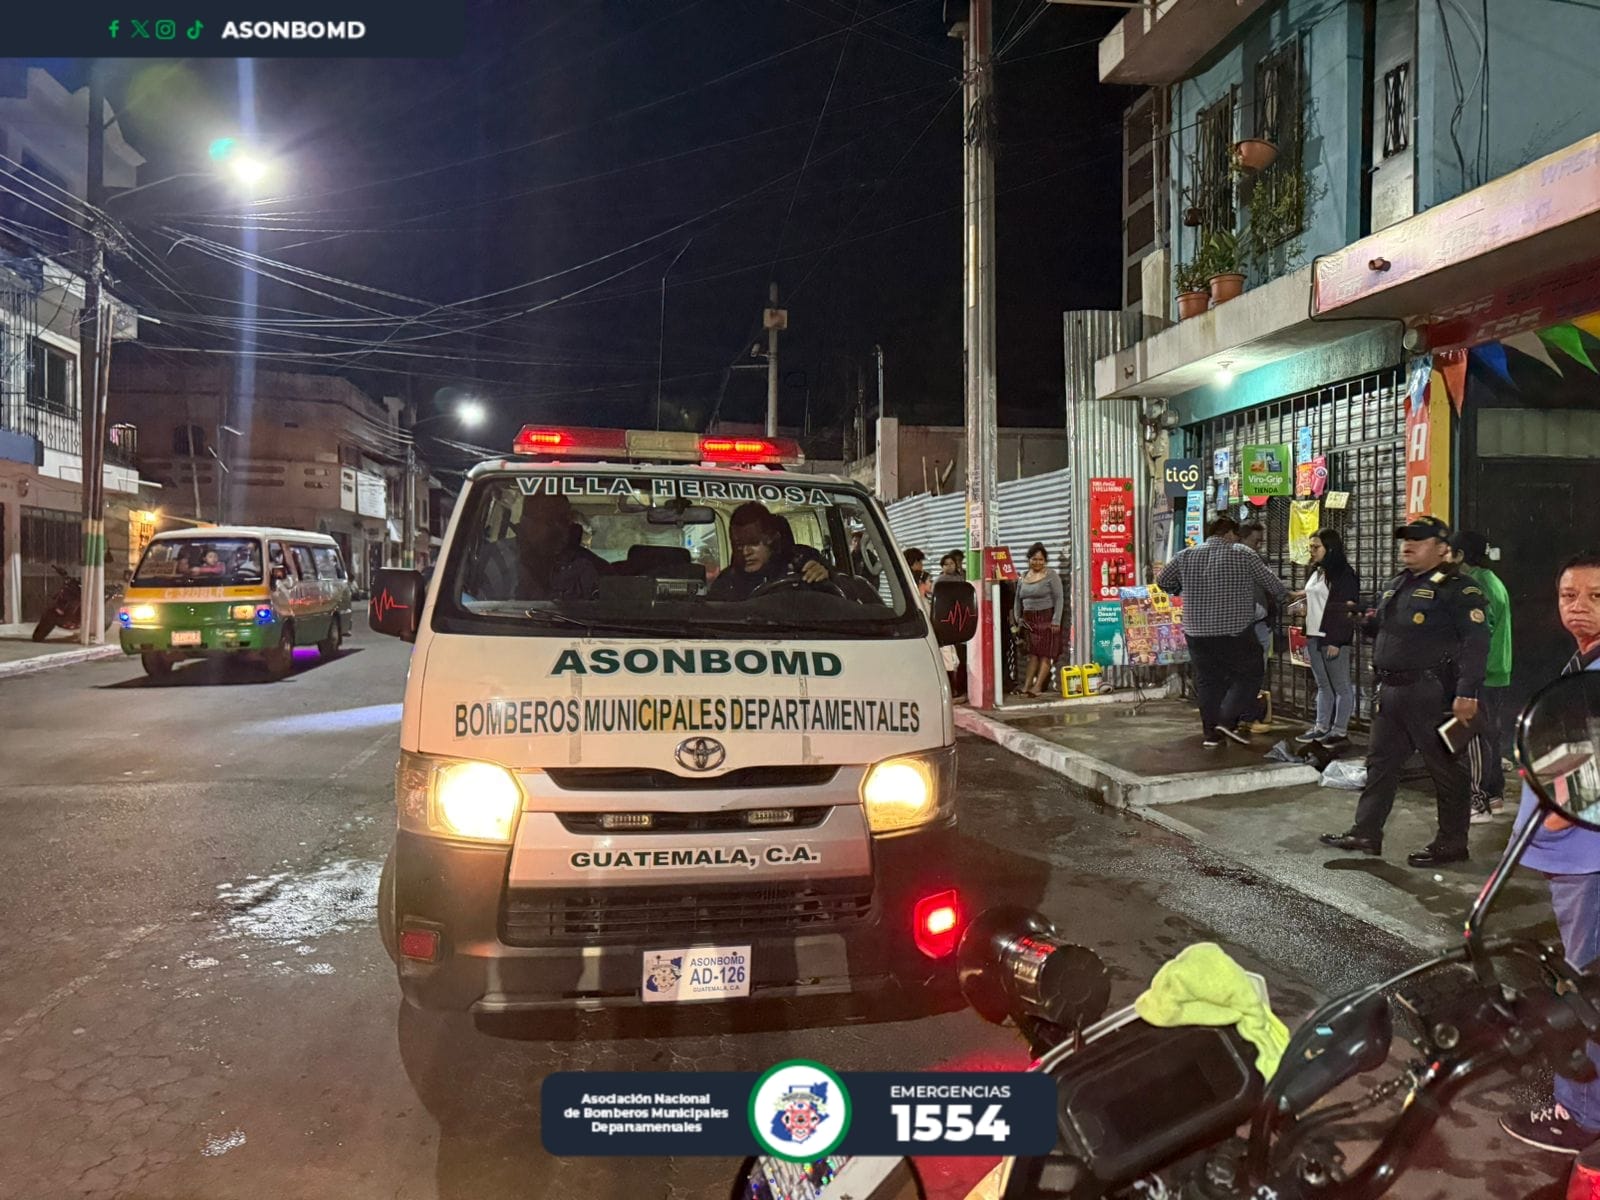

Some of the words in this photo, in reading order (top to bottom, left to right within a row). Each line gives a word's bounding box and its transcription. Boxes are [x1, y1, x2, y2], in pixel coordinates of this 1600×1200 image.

[516, 477, 637, 496] VILLA
[651, 479, 833, 507] HERMOSA
[551, 648, 843, 677] ASONBOMD
[455, 699, 580, 736] BOMBEROS
[583, 698, 727, 732] MUNICIPALES
[730, 698, 920, 734] DEPARTAMENTALES
[570, 849, 757, 868] GUATEMALA,
[765, 846, 819, 862] C.A.
[690, 956, 745, 967] ASONBOMD
[689, 967, 745, 985] AD-126
